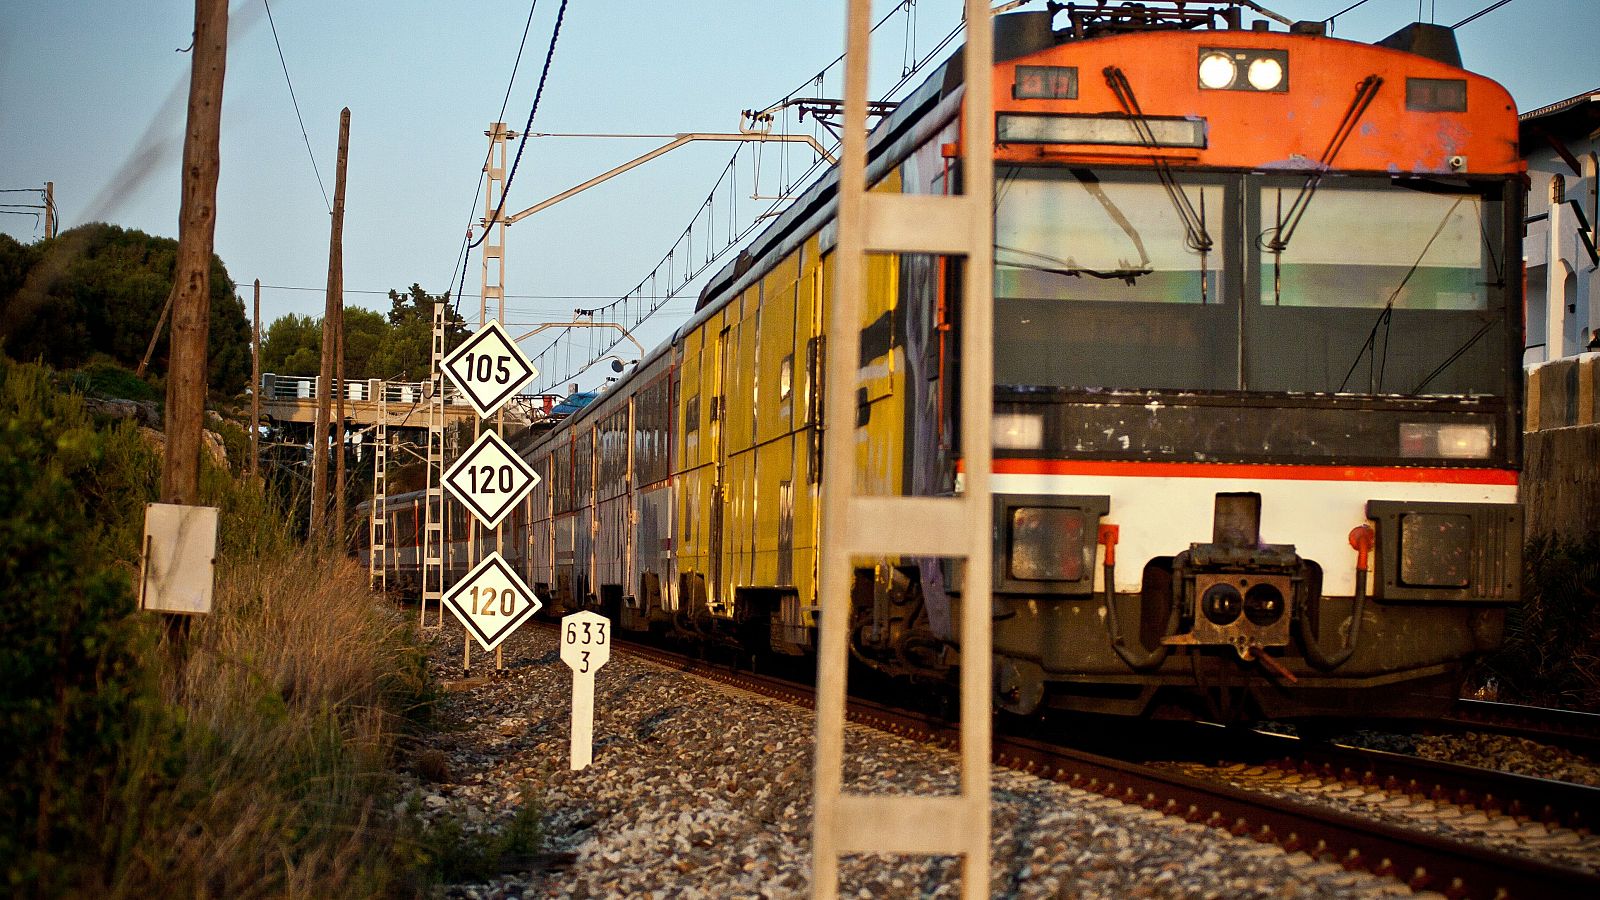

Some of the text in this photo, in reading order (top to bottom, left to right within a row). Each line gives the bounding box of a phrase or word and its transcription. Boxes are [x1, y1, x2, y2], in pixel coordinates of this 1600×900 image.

[465, 352, 511, 385] 105
[468, 465, 514, 494] 120
[470, 586, 516, 616] 120
[566, 622, 605, 645] 633
[579, 651, 590, 673] 3
